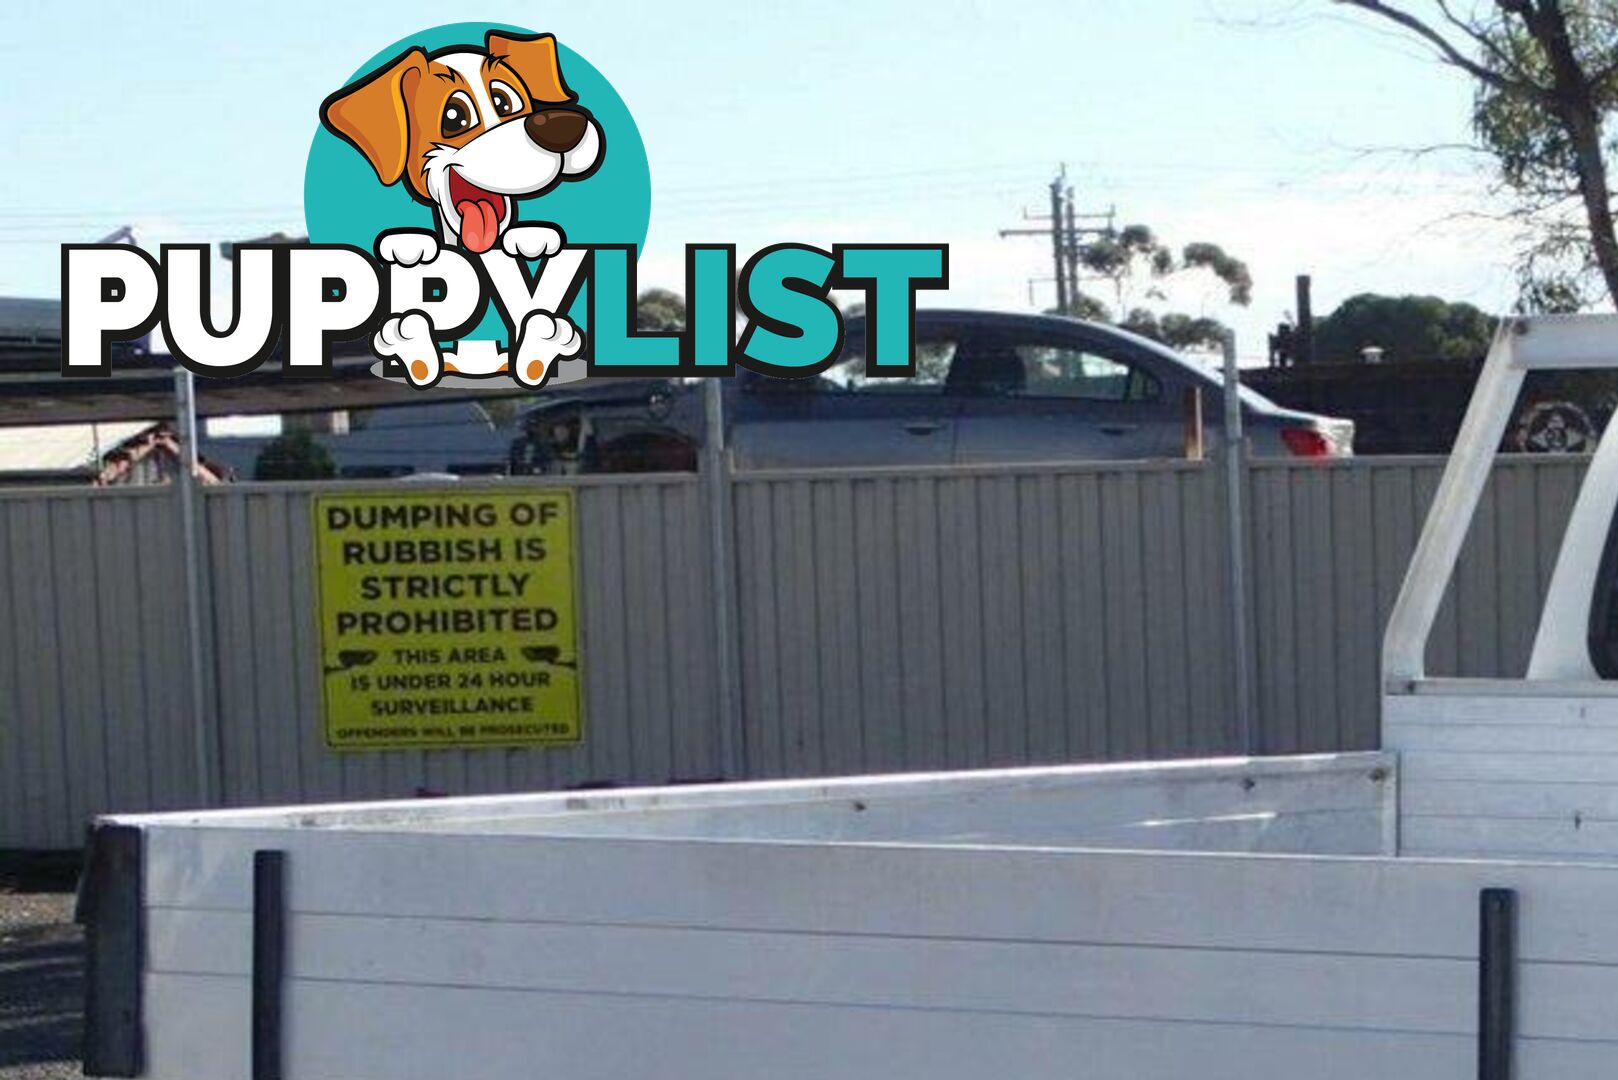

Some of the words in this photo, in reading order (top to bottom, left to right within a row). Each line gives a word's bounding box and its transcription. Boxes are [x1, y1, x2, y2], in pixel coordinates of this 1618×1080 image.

[326, 504, 498, 530] DUMPING
[510, 502, 558, 526] OF
[343, 538, 502, 565] RUBBISH
[515, 538, 546, 561] IS
[361, 573, 530, 600] STRICTLY
[337, 608, 558, 636] PROHIBITED
[393, 649, 440, 665] THIS
[449, 647, 506, 664] AREA
[352, 676, 370, 691] IS
[377, 674, 450, 691] UNDER
[459, 673, 482, 688] 24
[490, 671, 551, 688] HOUR
[371, 697, 534, 716] SURVEILLANCE
[337, 726, 417, 739] OFFENDERS
[422, 726, 455, 738] WILL
[460, 725, 475, 737] BE
[480, 723, 570, 737] PROSECUTED
